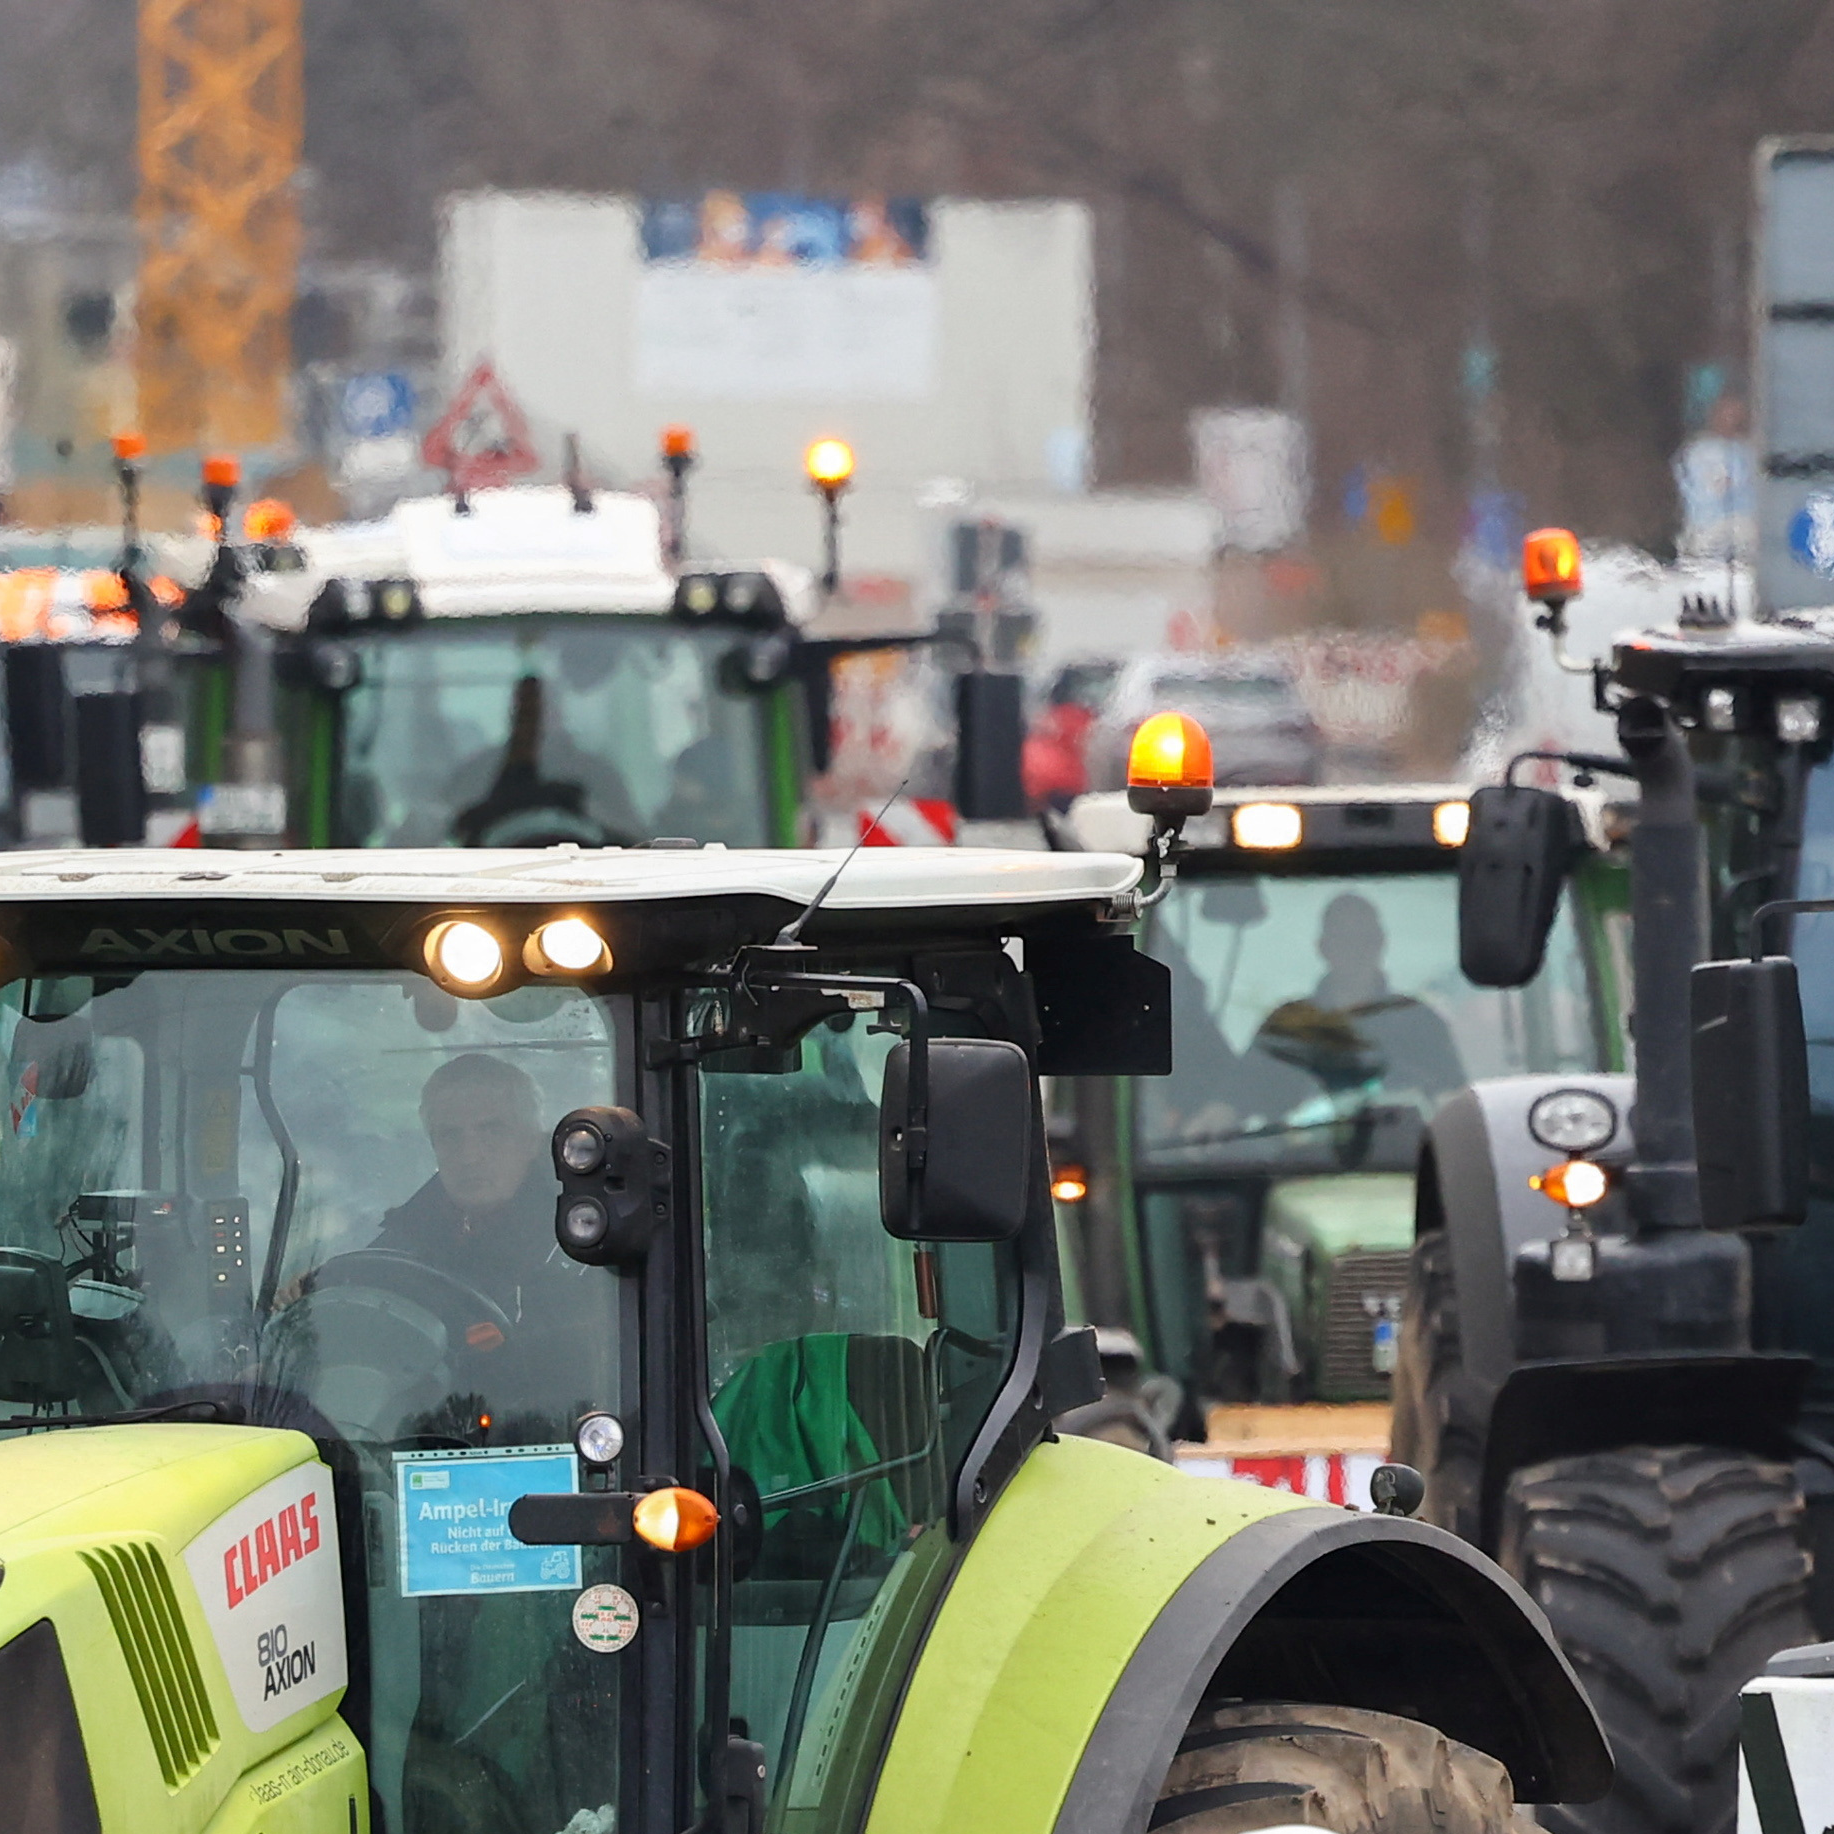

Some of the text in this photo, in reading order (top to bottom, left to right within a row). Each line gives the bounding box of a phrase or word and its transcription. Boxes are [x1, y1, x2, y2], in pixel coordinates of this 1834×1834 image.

[79, 927, 351, 955] AXION
[418, 1497, 512, 1523] Ampel-Ir
[447, 1525, 482, 1540] Nicht
[484, 1523, 505, 1537] auf
[223, 1491, 320, 1611] CLAAS
[480, 1539, 501, 1552] der
[470, 1571, 515, 1584] Bauern
[257, 1623, 288, 1668] 810
[263, 1640, 316, 1702] AXION
